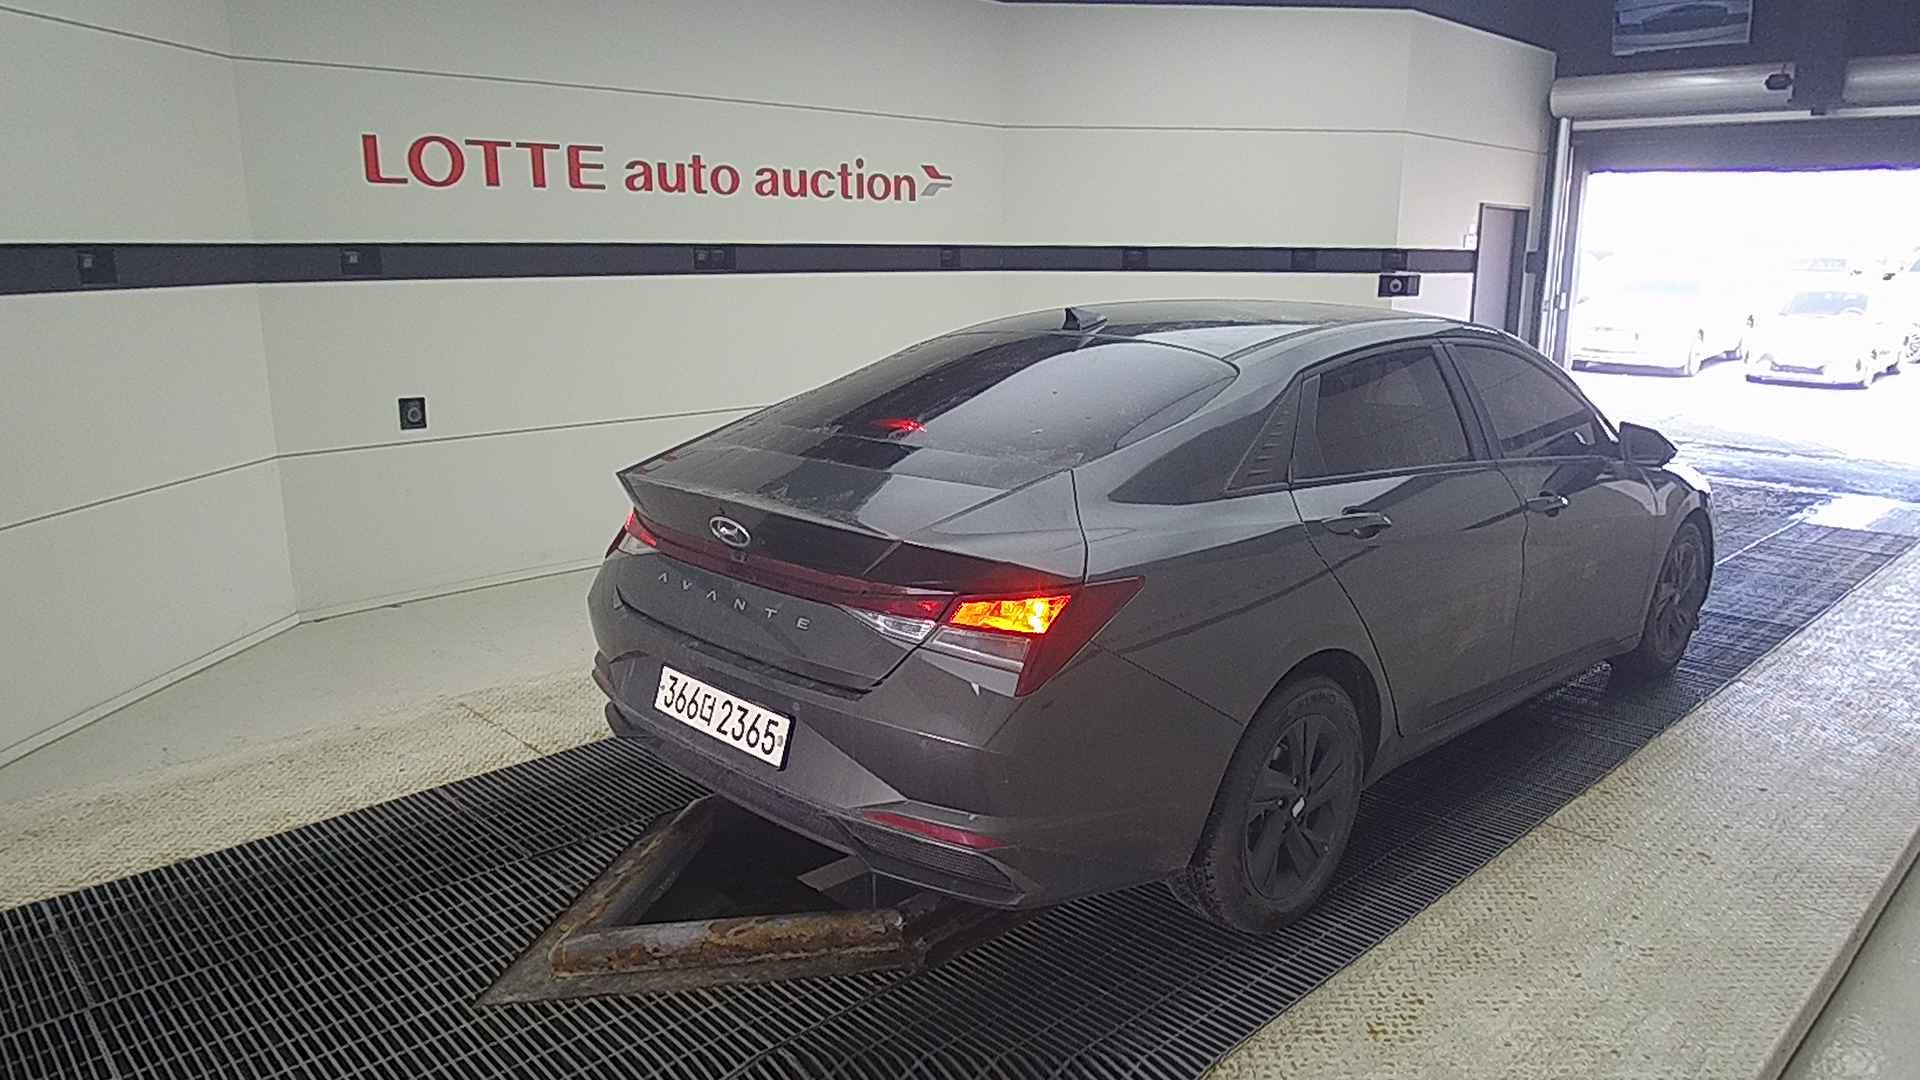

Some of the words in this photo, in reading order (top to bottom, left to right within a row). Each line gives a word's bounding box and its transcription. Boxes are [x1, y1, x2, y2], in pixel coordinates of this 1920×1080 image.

[361, 133, 605, 190] LOTTE
[624, 154, 740, 195] auto
[754, 157, 916, 201] auction
[658, 572, 811, 630] AVANTE
